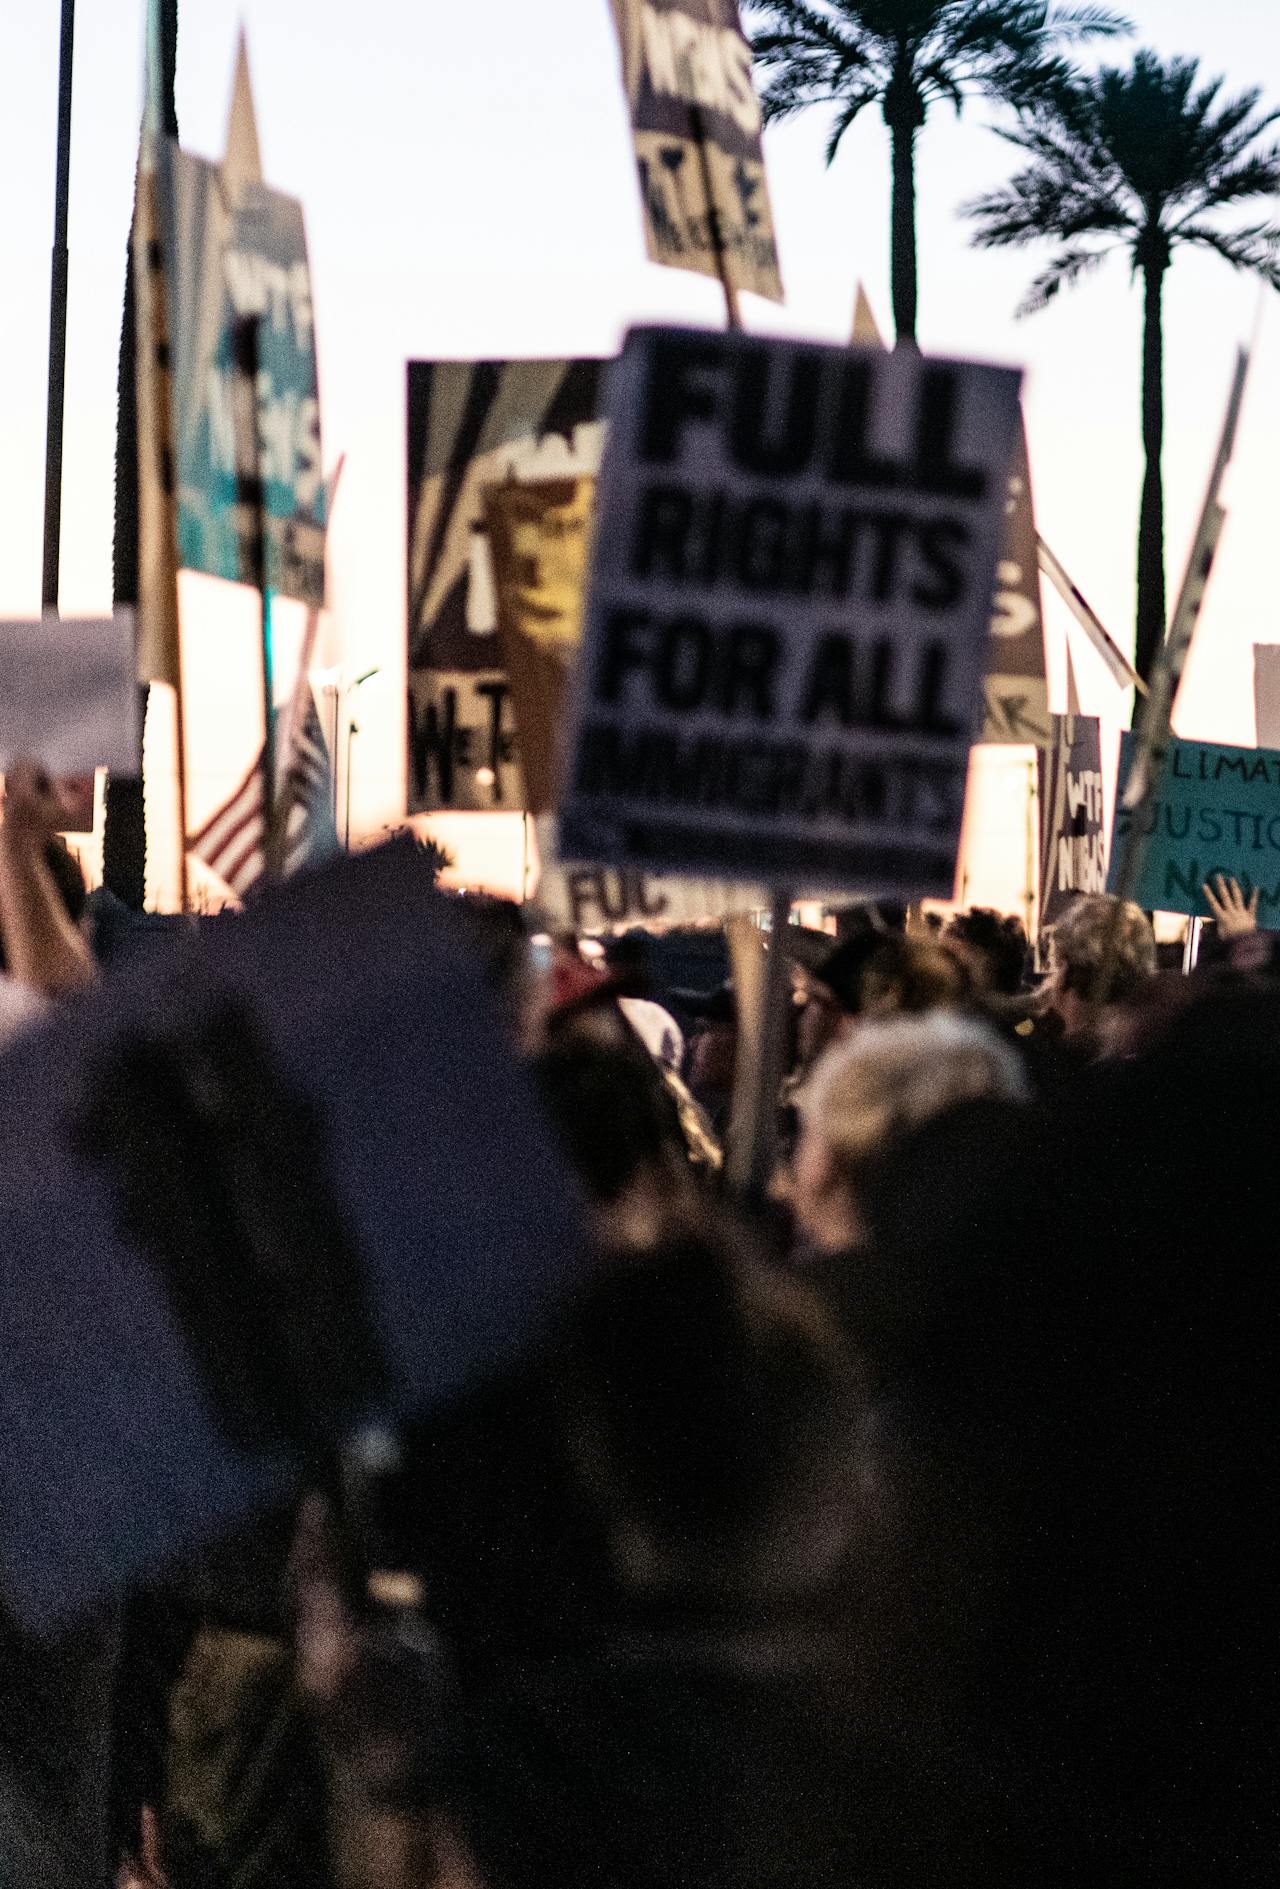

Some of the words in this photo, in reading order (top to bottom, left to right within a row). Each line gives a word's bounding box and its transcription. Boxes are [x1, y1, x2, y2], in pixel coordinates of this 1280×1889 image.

[642, 340, 988, 498] FULL
[632, 485, 972, 608] RIGHTS
[602, 608, 788, 717] FOR
[806, 632, 974, 735] ALL
